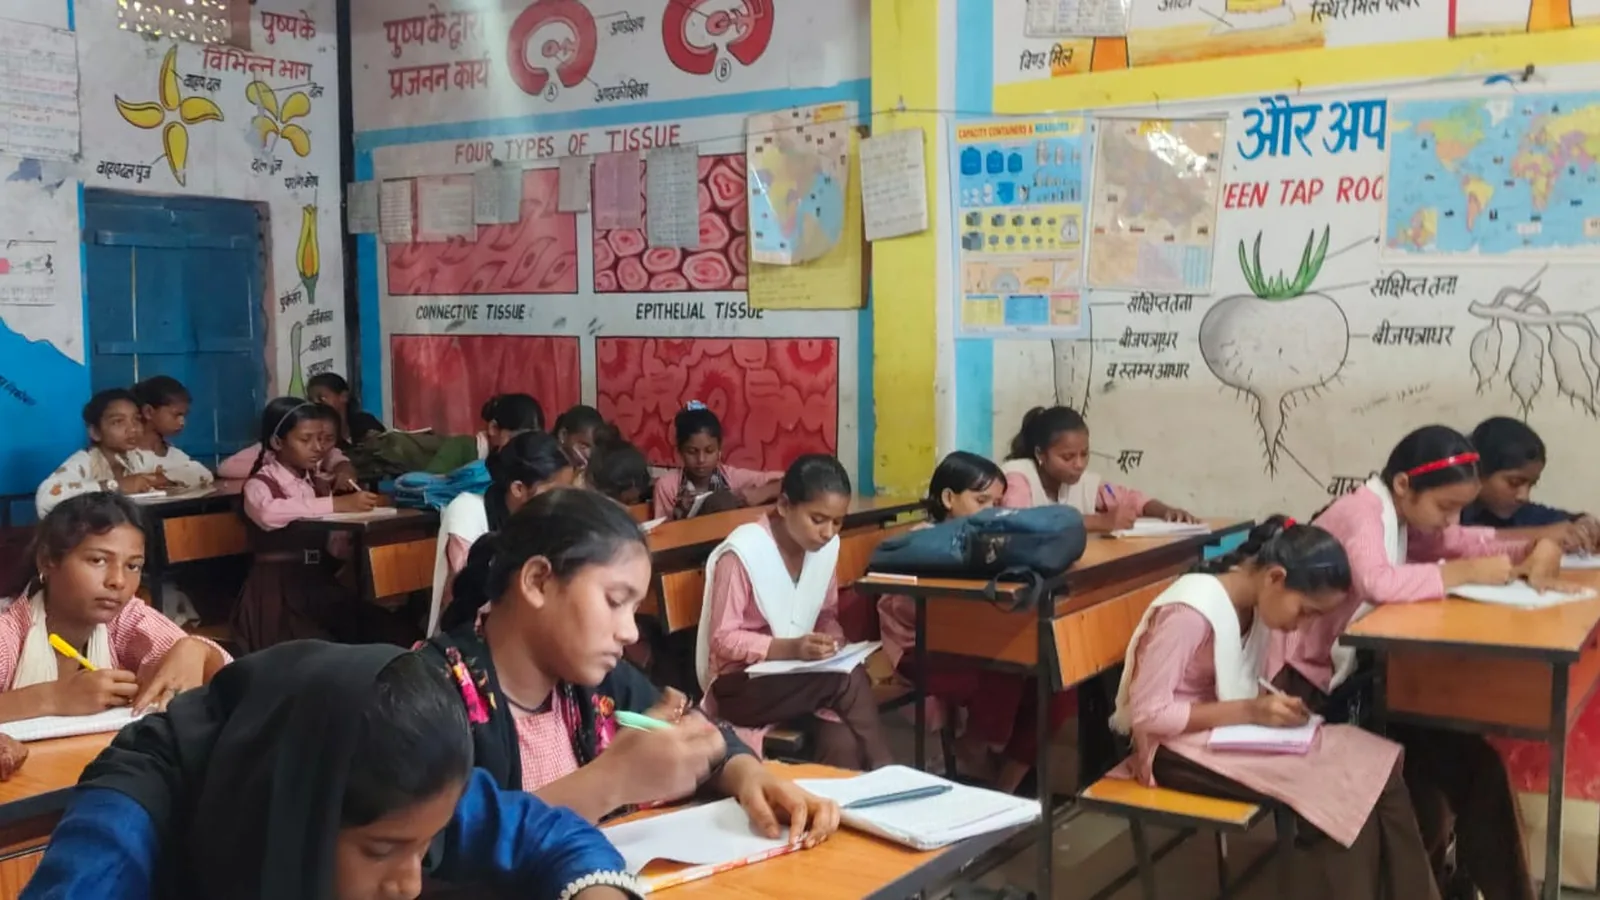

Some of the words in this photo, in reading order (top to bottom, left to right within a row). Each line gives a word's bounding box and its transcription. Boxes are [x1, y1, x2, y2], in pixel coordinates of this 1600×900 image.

[261, 10, 299, 45] पुष्प
[299, 9, 317, 41] के
[383, 15, 427, 58] पुष्प
[427, 3, 447, 43] के
[203, 45, 276, 77] विभिन्न
[279, 59, 314, 82] भाग
[388, 63, 451, 99] प्रजनन
[454, 50, 492, 90] कार्य
[454, 141, 495, 165] FOUR
[504, 135, 554, 159] TYPES
[568, 133, 590, 155] OF
[605, 124, 682, 153] TISSUE
[1237, 94, 1323, 160] और
[1224, 180, 1269, 209] EEN
[1280, 178, 1325, 205] TAP
[1428, 275, 1459, 298] तना
[415, 305, 479, 321] CONNECTIVE
[486, 303, 526, 320] TISSUE
[635, 302, 706, 320] EPITHELIAL
[714, 301, 765, 320] TISSUE
[1116, 449, 1144, 475] मूल
